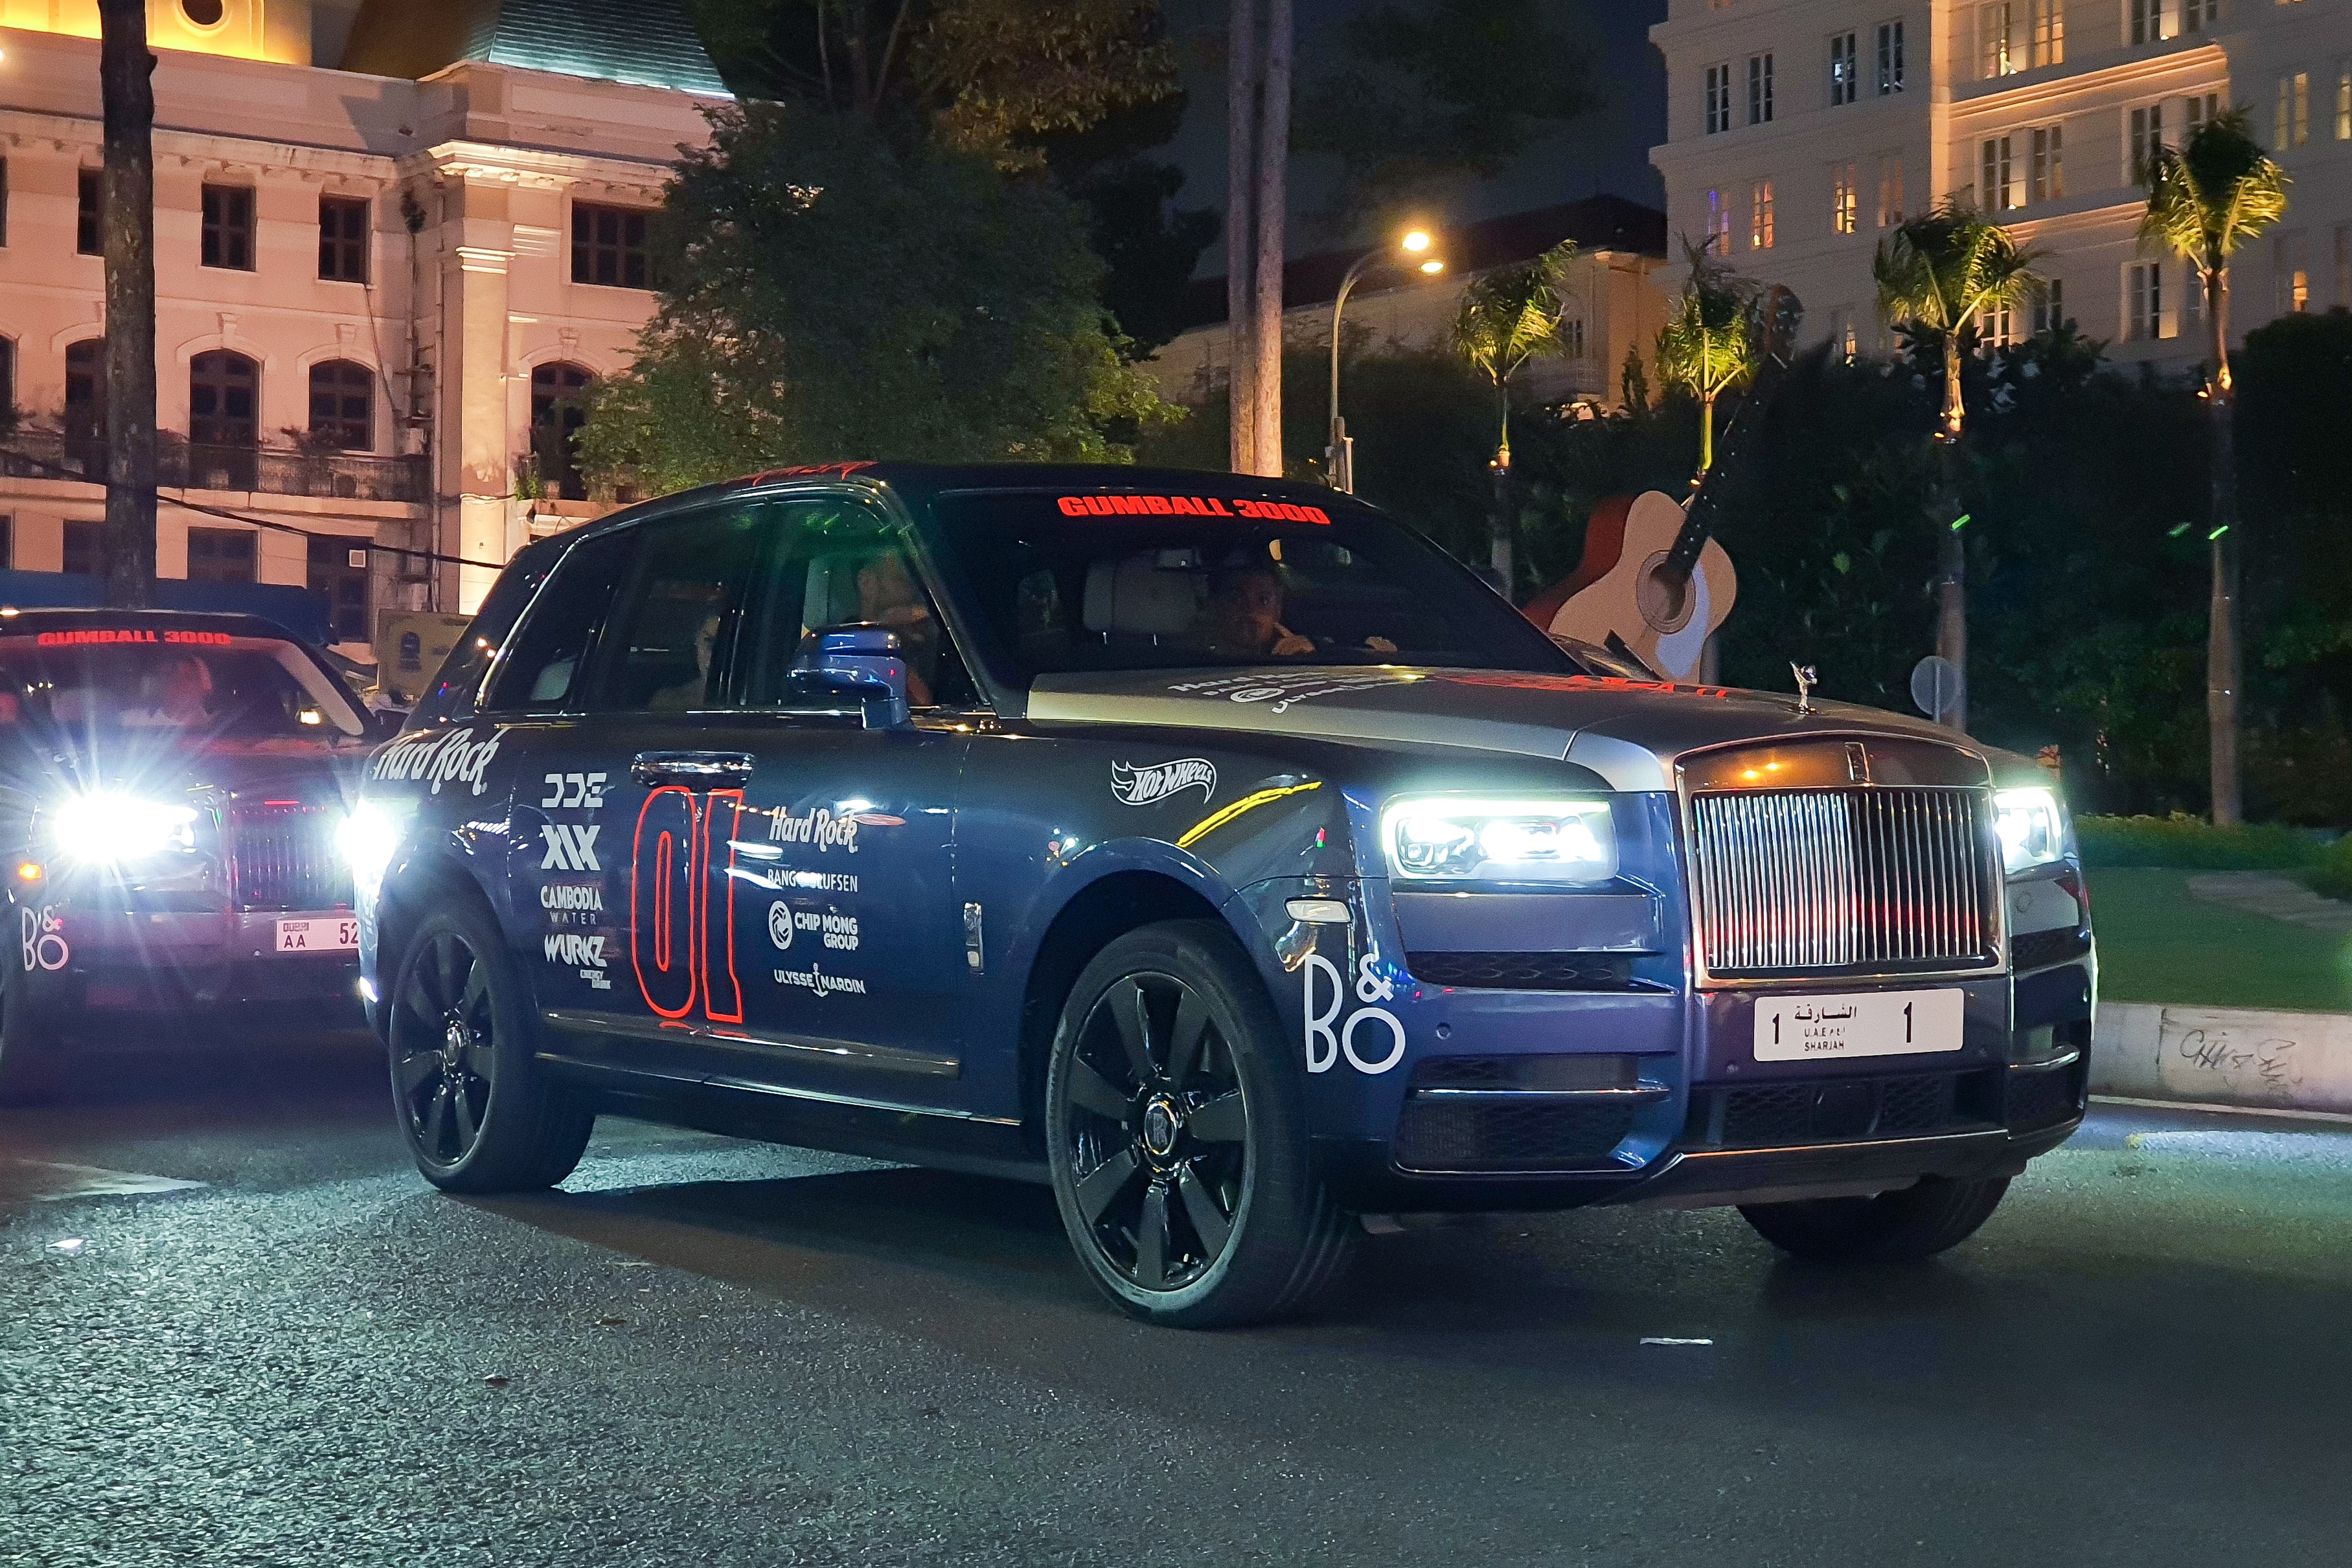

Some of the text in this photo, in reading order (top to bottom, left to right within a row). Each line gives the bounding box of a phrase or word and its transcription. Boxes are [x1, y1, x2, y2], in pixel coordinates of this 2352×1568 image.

[1057, 495, 1331, 525] GUMBALL 3000
[38, 630, 231, 646] GUMBALL 3000
[372, 727, 510, 796] Hard Rock
[769, 806, 858, 854] Hard Rock
[768, 869, 797, 887] BANG
[540, 885, 604, 911] CAMBODIA
[630, 786, 744, 1024] 01
[549, 911, 597, 925] WATER
[794, 912, 858, 935] CHIP MONG
[544, 934, 608, 967] WURKZ
[823, 933, 859, 951] GROUP
[774, 970, 866, 994] ULYSSE NARDIN
[1772, 1012, 1780, 1045] 1
[1903, 1001, 1913, 1043] 1
[1804, 1040, 1844, 1051] SHARJAH
